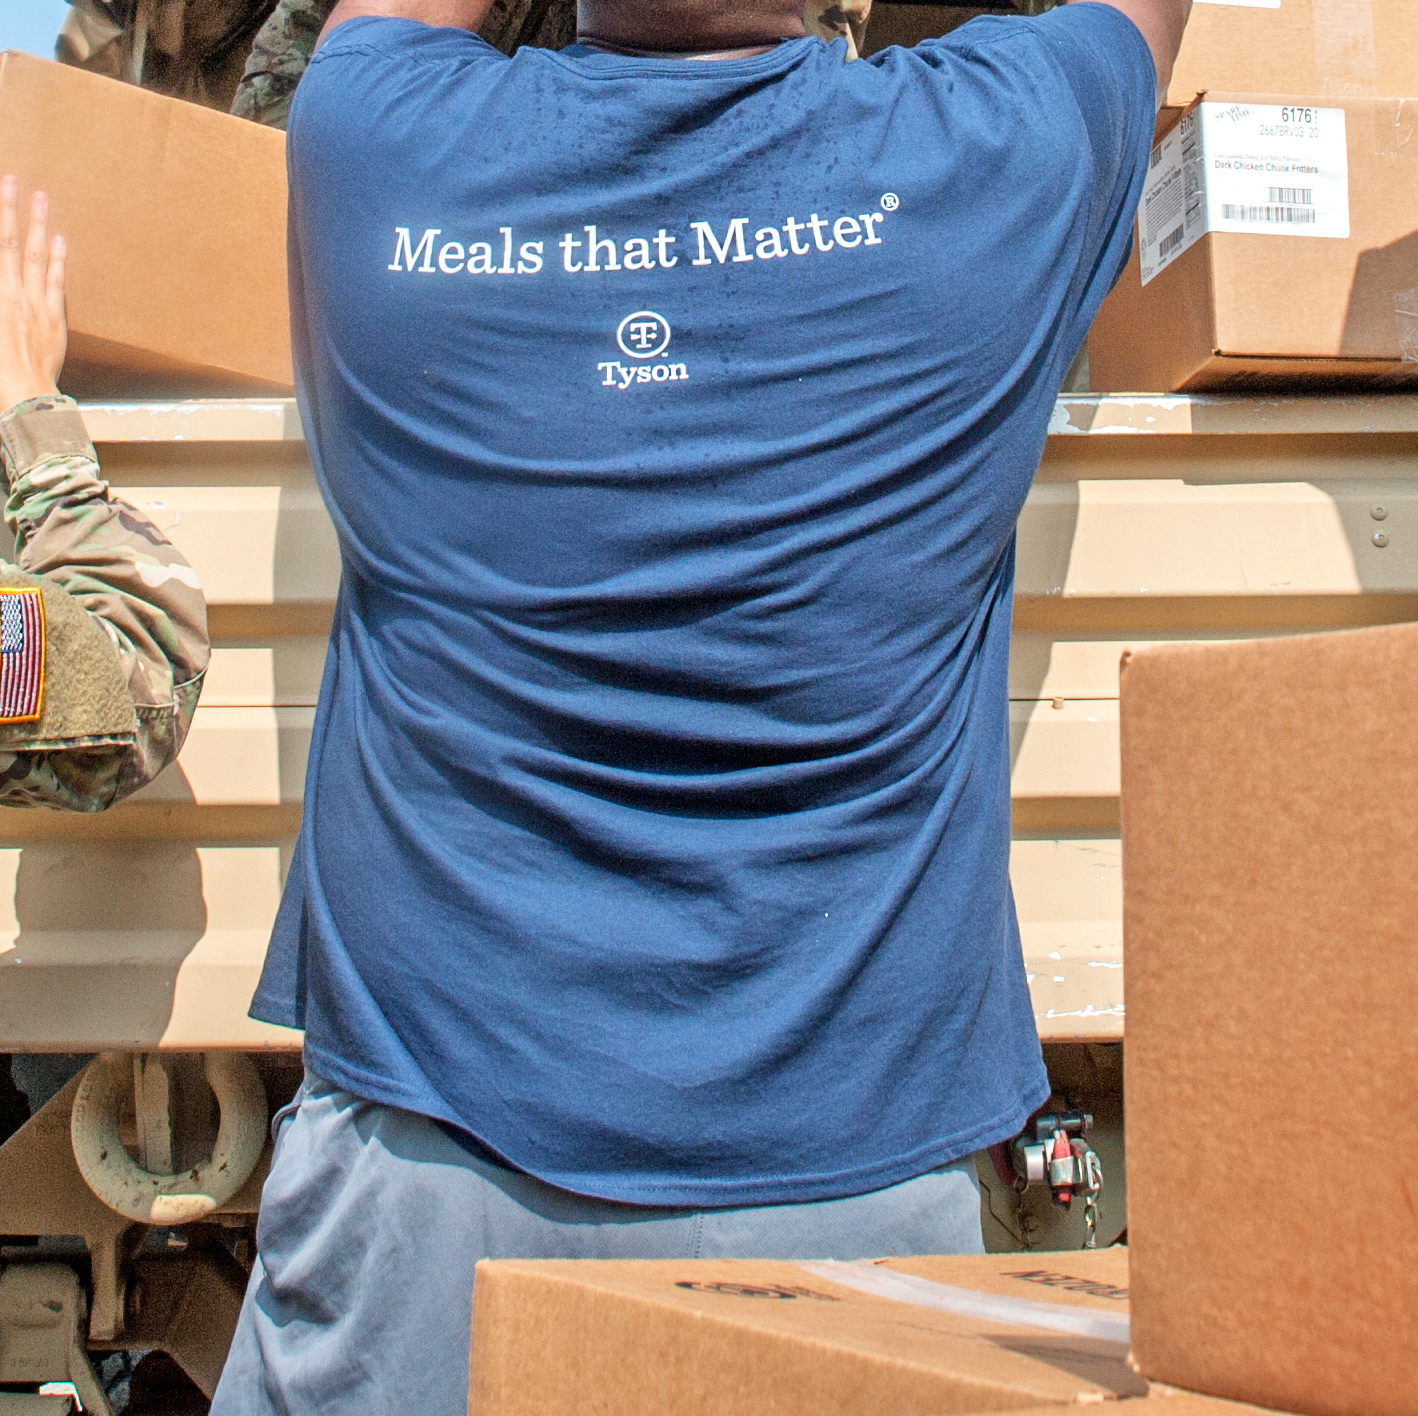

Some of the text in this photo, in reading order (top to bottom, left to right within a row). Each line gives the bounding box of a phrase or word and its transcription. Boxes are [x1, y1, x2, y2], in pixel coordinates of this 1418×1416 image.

[1214, 104, 1241, 122] SPARE
[1281, 107, 1313, 124] 6176
[1214, 160, 1319, 174] Dark Chicken Chunk Fritters
[386, 226, 545, 275] Meals
[559, 225, 678, 273] that
[596, 360, 690, 391] Tyson
